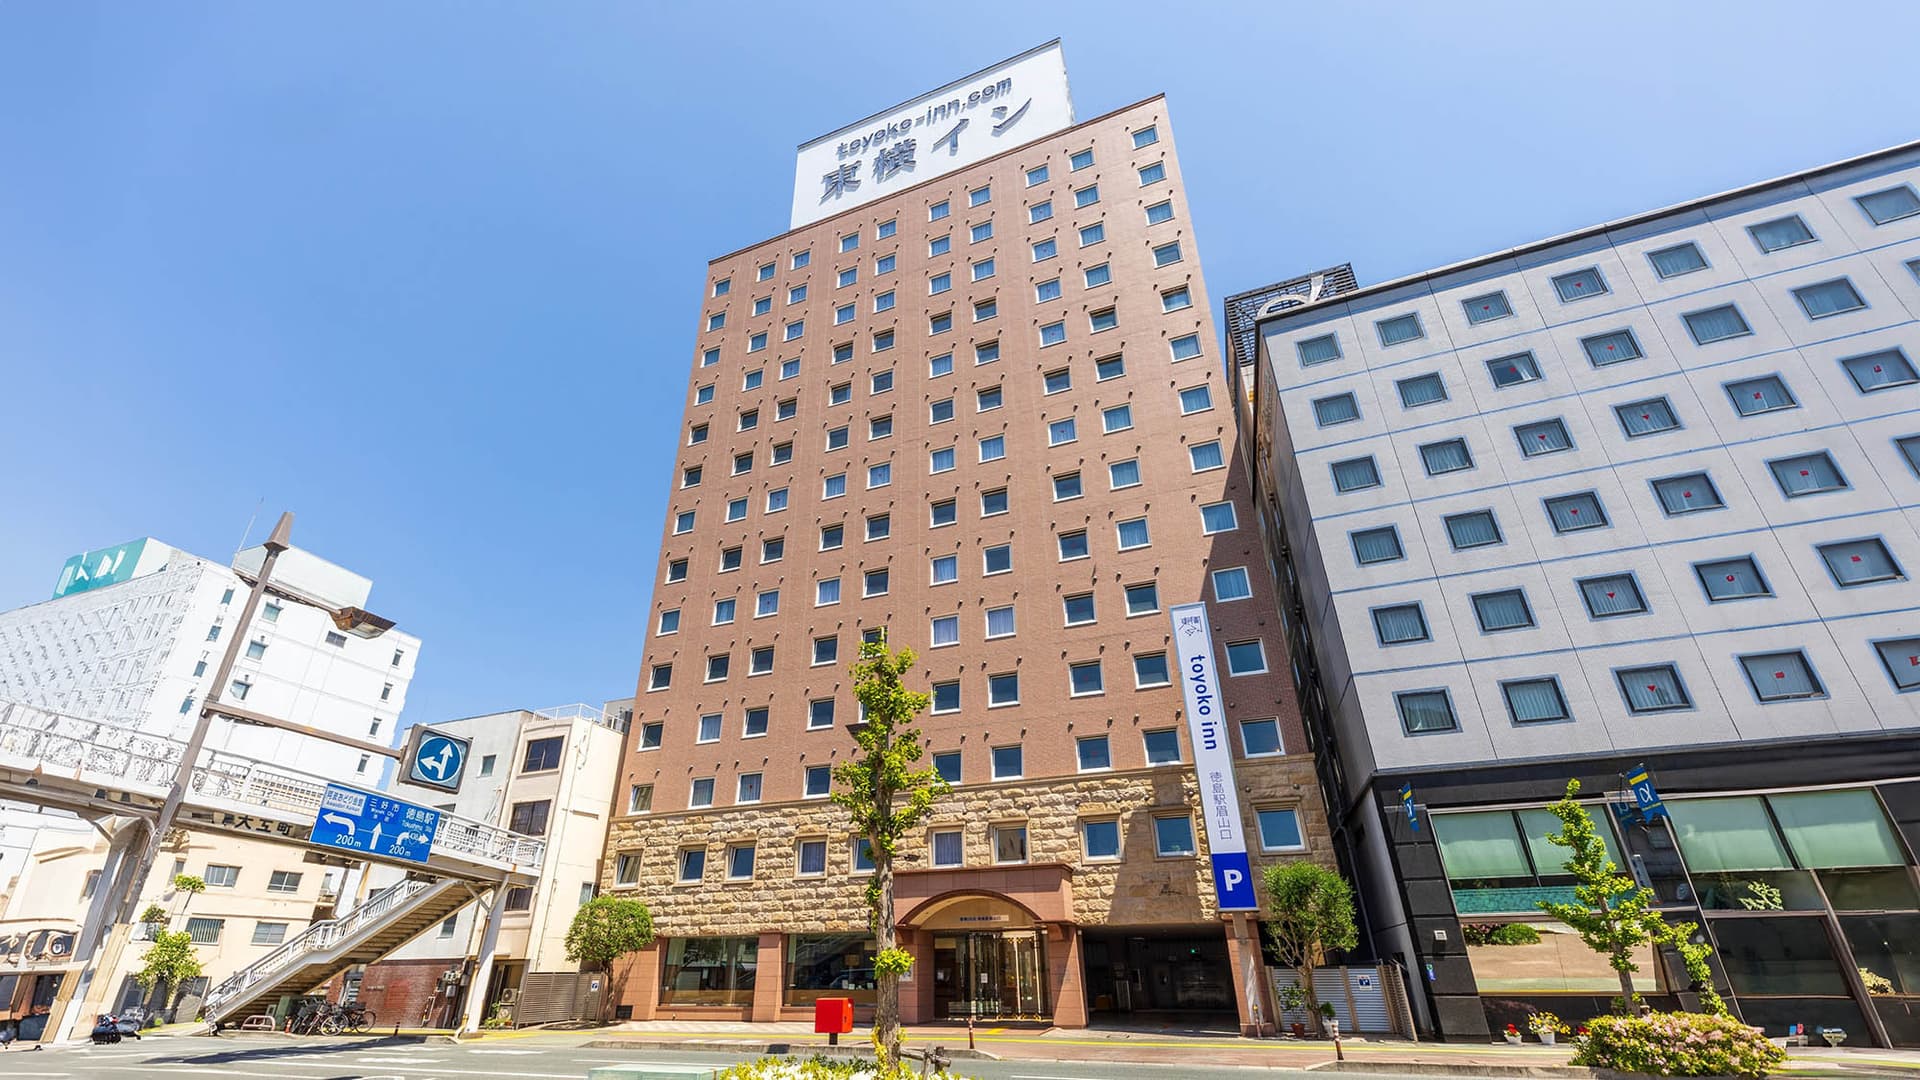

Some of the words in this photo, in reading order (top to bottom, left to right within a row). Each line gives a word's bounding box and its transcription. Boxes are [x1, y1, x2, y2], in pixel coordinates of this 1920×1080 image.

[820, 97, 1032, 201] 東横イン
[1190, 655, 1213, 716] toyoko
[1201, 722, 1218, 750] inn
[1209, 771, 1232, 840] 徳島駅眉山口
[335, 834, 353, 846] 200
[354, 840, 362, 848] m
[388, 844, 405, 856] 200
[1224, 869, 1242, 891] P
